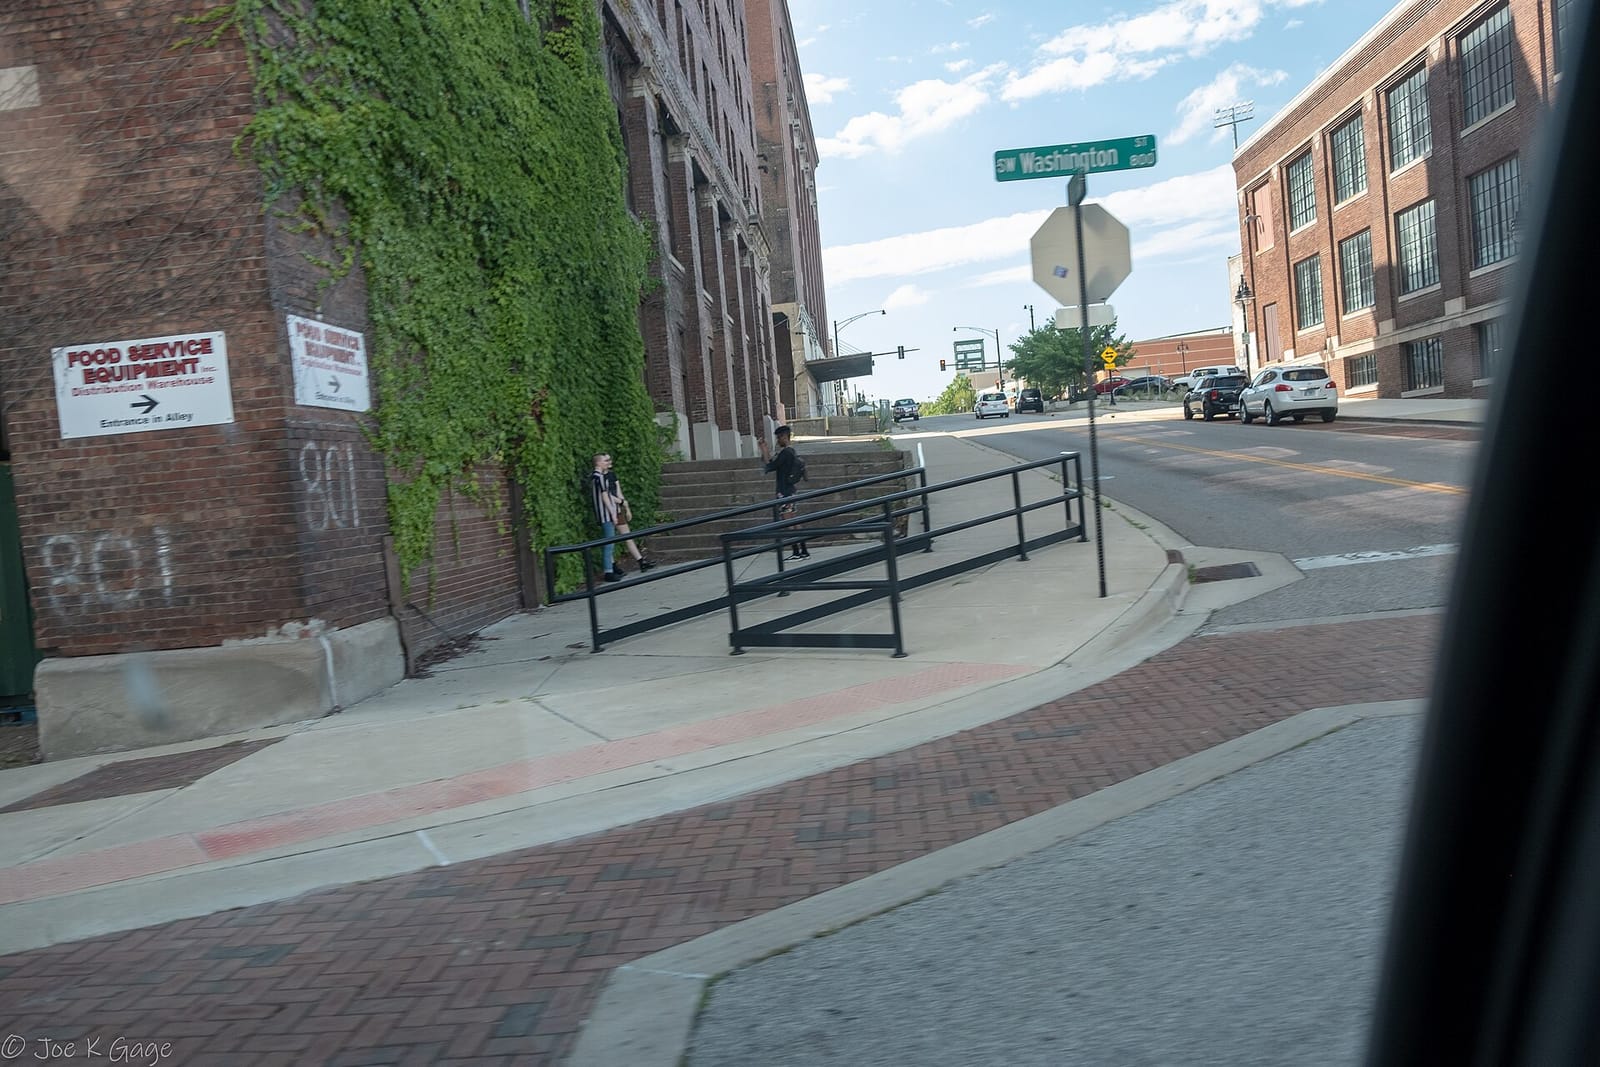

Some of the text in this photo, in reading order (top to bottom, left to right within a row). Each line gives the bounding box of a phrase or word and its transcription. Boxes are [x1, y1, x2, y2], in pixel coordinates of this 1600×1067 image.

[996, 157, 1016, 173] SW
[1020, 147, 1119, 174] Washington
[67, 338, 213, 368] FOOD SERVICE
[83, 358, 199, 385] EQUIPMENT
[71, 376, 215, 397] Distribution Warehouse
[100, 411, 193, 428] Entrance in Alley
